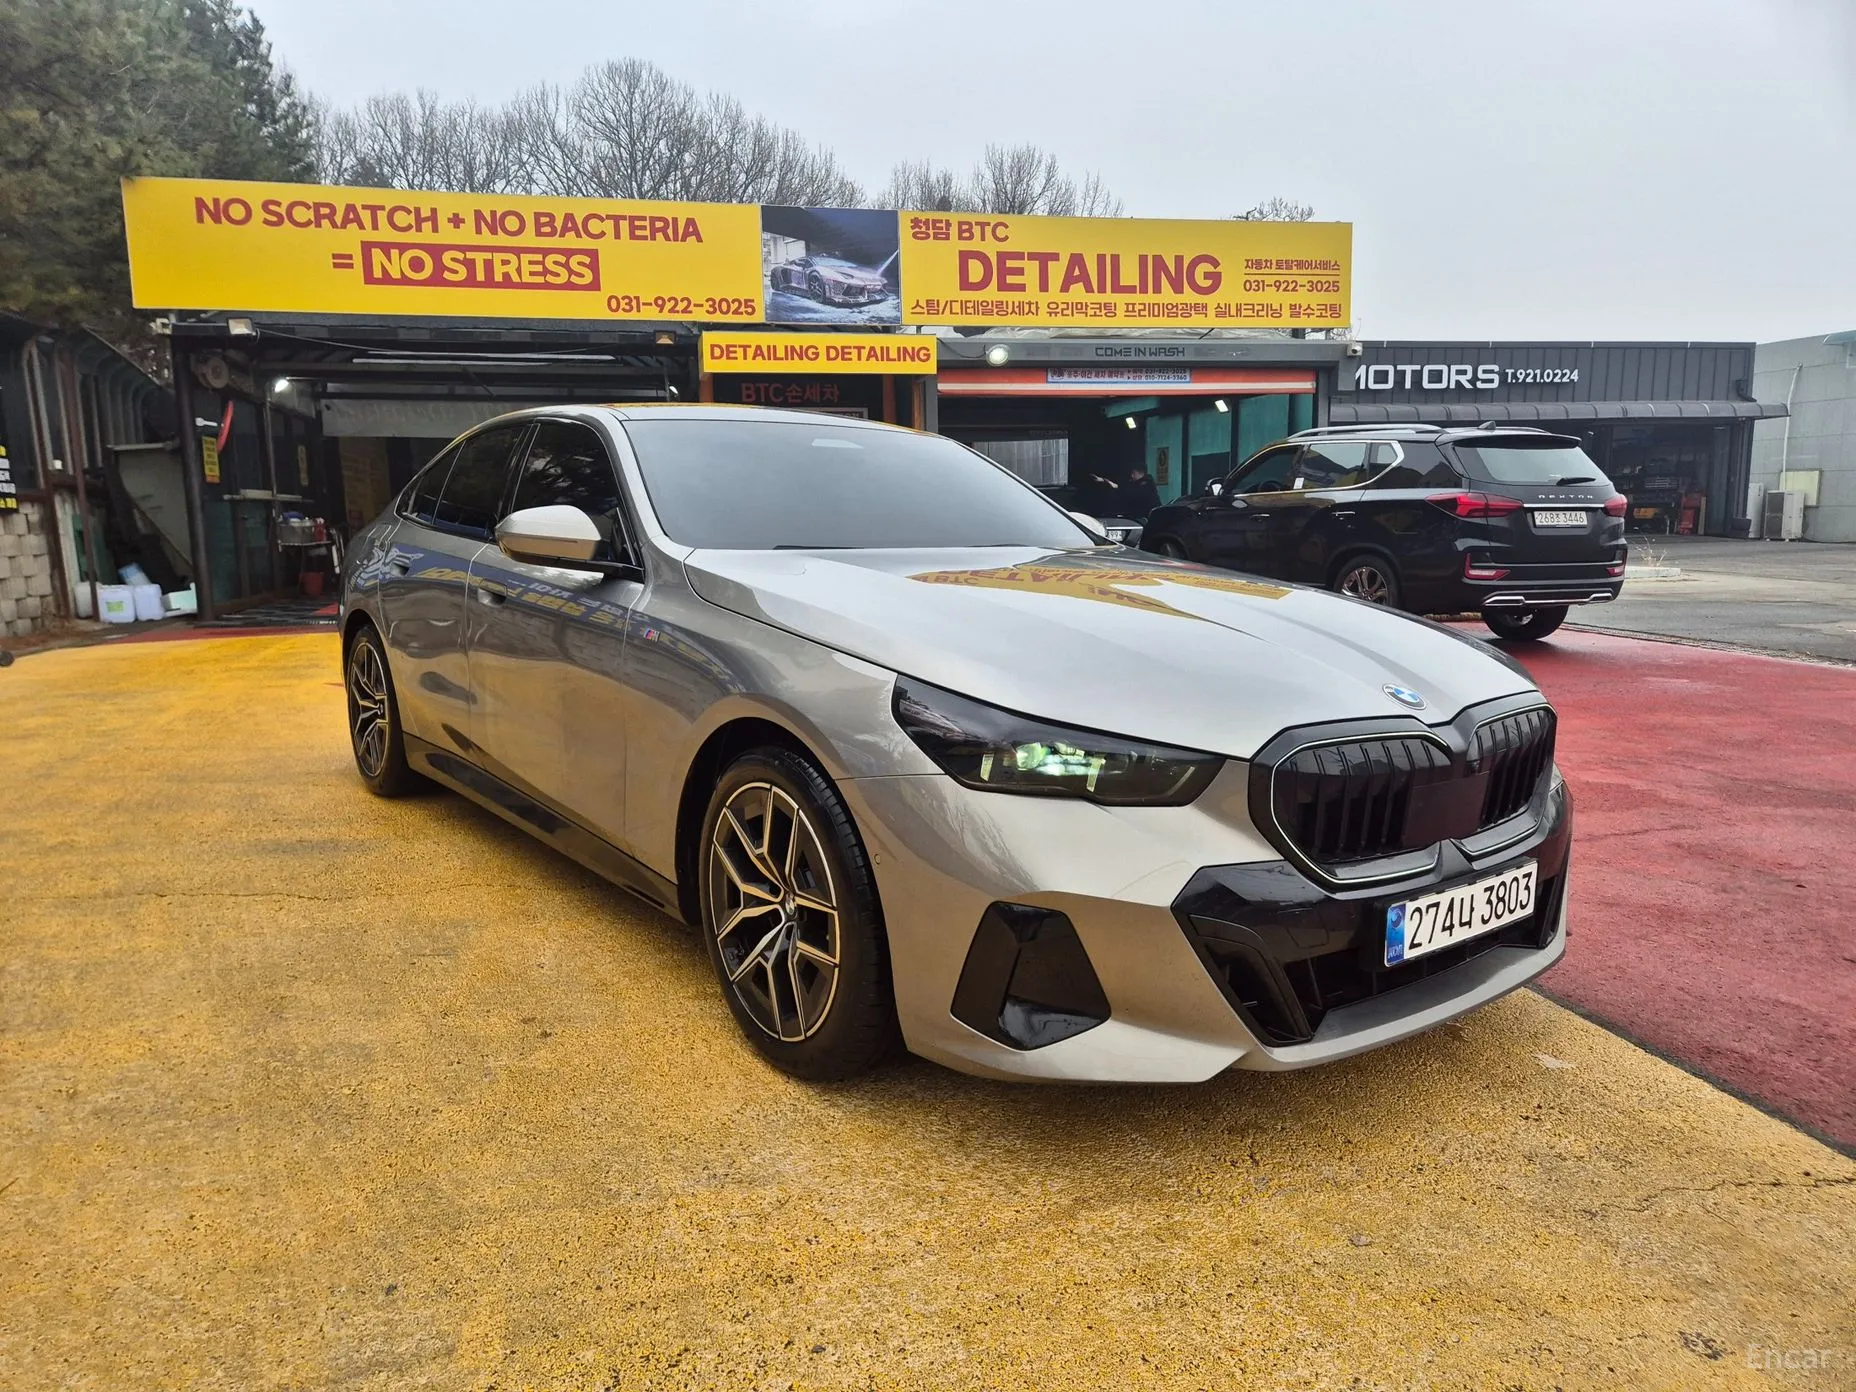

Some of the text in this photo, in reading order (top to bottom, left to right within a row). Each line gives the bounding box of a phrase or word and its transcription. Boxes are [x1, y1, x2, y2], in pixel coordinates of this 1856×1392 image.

[194, 196, 253, 226] NO
[261, 199, 439, 234] SCRATCH
[473, 209, 526, 237] NO
[533, 211, 703, 243] BACTERIA
[910, 217, 1010, 243] 청담 BTC
[371, 247, 434, 281] NO
[441, 250, 594, 285] STRESS
[958, 249, 1223, 296] DETAILING
[1244, 258, 1341, 271] 자동차 토탈케어서비스
[1243, 278, 1340, 293] 031-922-3025
[606, 294, 757, 317] 031-922-3025
[910, 298, 1343, 319] 스팀/디테일링세차 유리막코팅 프리미엄광택 실내크리닝 발수코팅
[709, 343, 931, 363] DETAILING DETAILING
[1095, 347, 1186, 357] COME IN WASH
[1505, 368, 1579, 384] T.921.0224
[740, 382, 840, 403] BTC손세차
[1481, 871, 1534, 925] 3803
